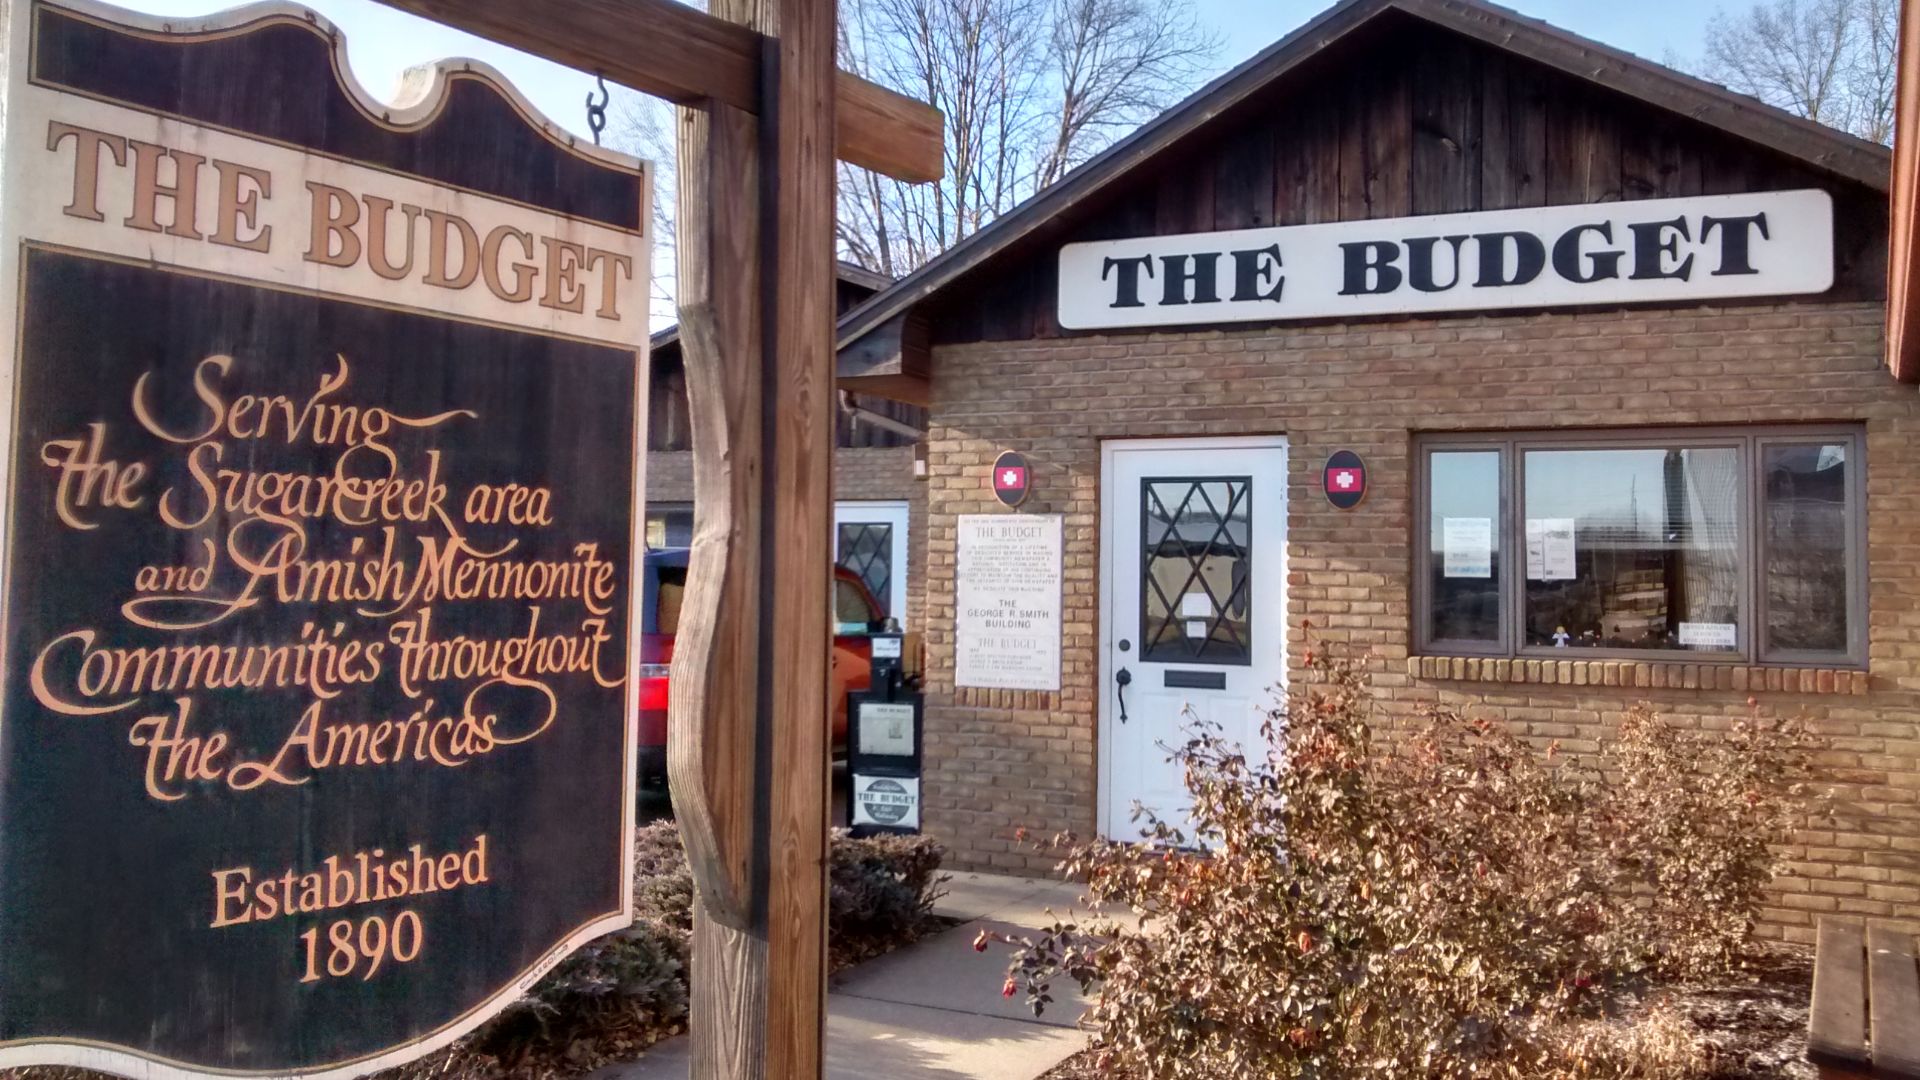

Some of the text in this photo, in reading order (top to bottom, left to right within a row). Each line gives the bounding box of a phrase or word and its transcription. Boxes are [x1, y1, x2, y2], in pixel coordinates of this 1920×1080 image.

[46, 120, 633, 321] THE BUDGET
[1101, 211, 1771, 308] THE BUDGET
[132, 354, 478, 450] Serving
[41, 423, 145, 529] the
[464, 480, 553, 526] area
[220, 517, 414, 618] Amish
[404, 535, 615, 614] Mennonite
[976, 526, 1042, 538] THE BUDGET
[967, 608, 1005, 618] GEORGE
[1019, 610, 1049, 619] SMITH
[985, 619, 1031, 629] BUILDING
[999, 599, 1017, 608] THE
[30, 605, 626, 715] Communities throughout
[129, 690, 550, 801] the Americas
[858, 792, 916, 805] THE BUDGET
[210, 833, 489, 929] Established
[300, 910, 423, 983] 1890
